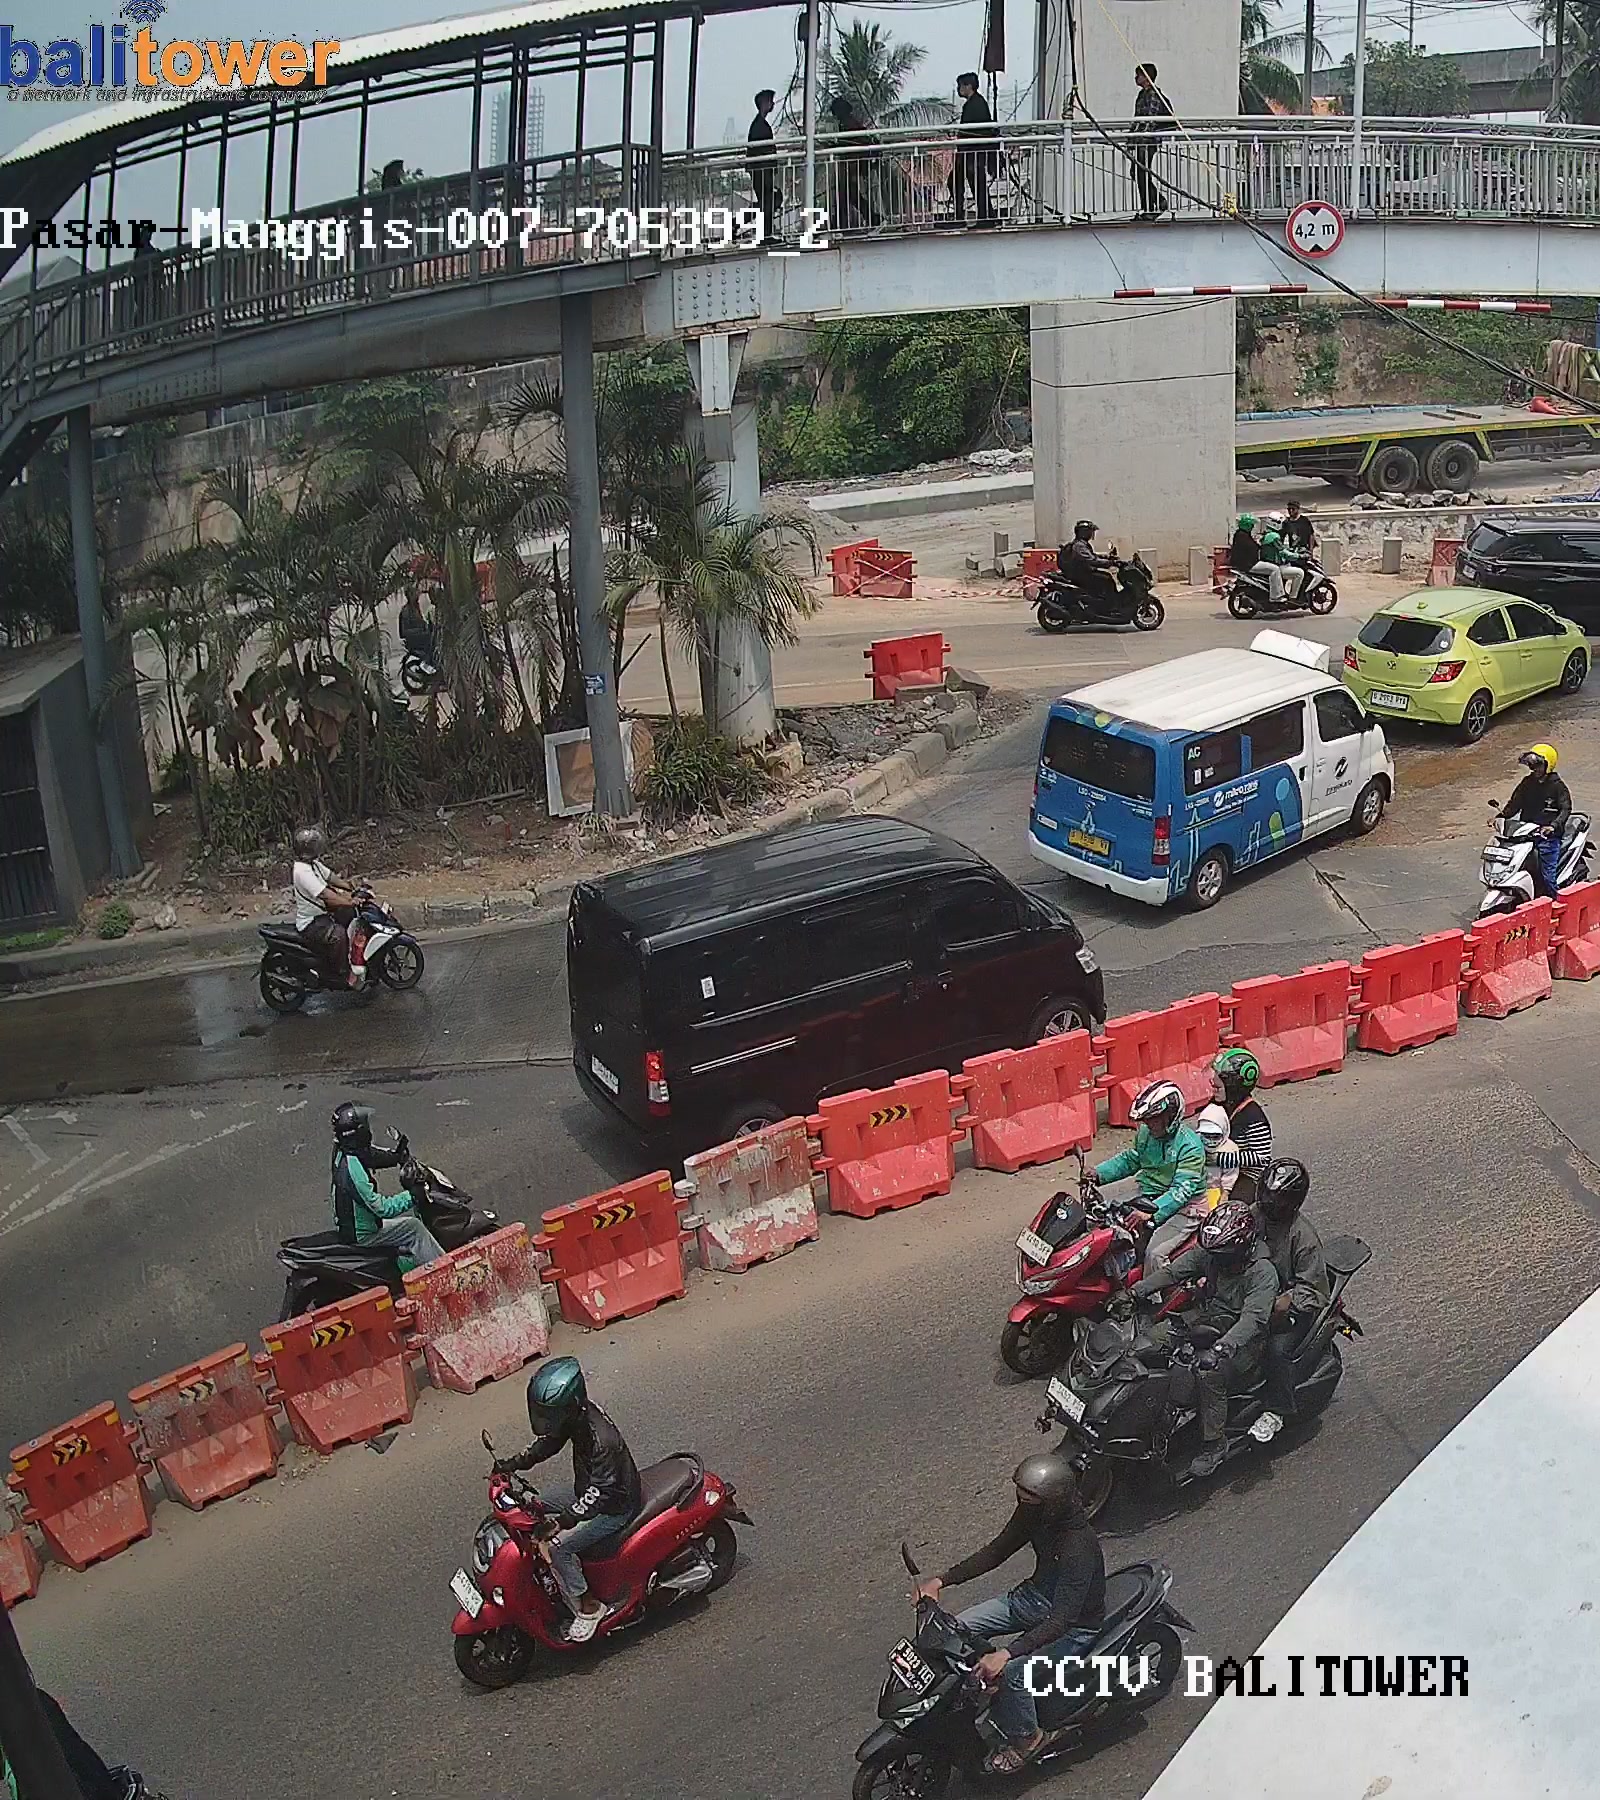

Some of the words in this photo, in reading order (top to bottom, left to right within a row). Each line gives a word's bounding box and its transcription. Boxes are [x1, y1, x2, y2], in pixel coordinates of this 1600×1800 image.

[1295, 223, 1315, 239] 4,2
[1322, 224, 1335, 235] m
[572, 1485, 600, 1515] Grab
